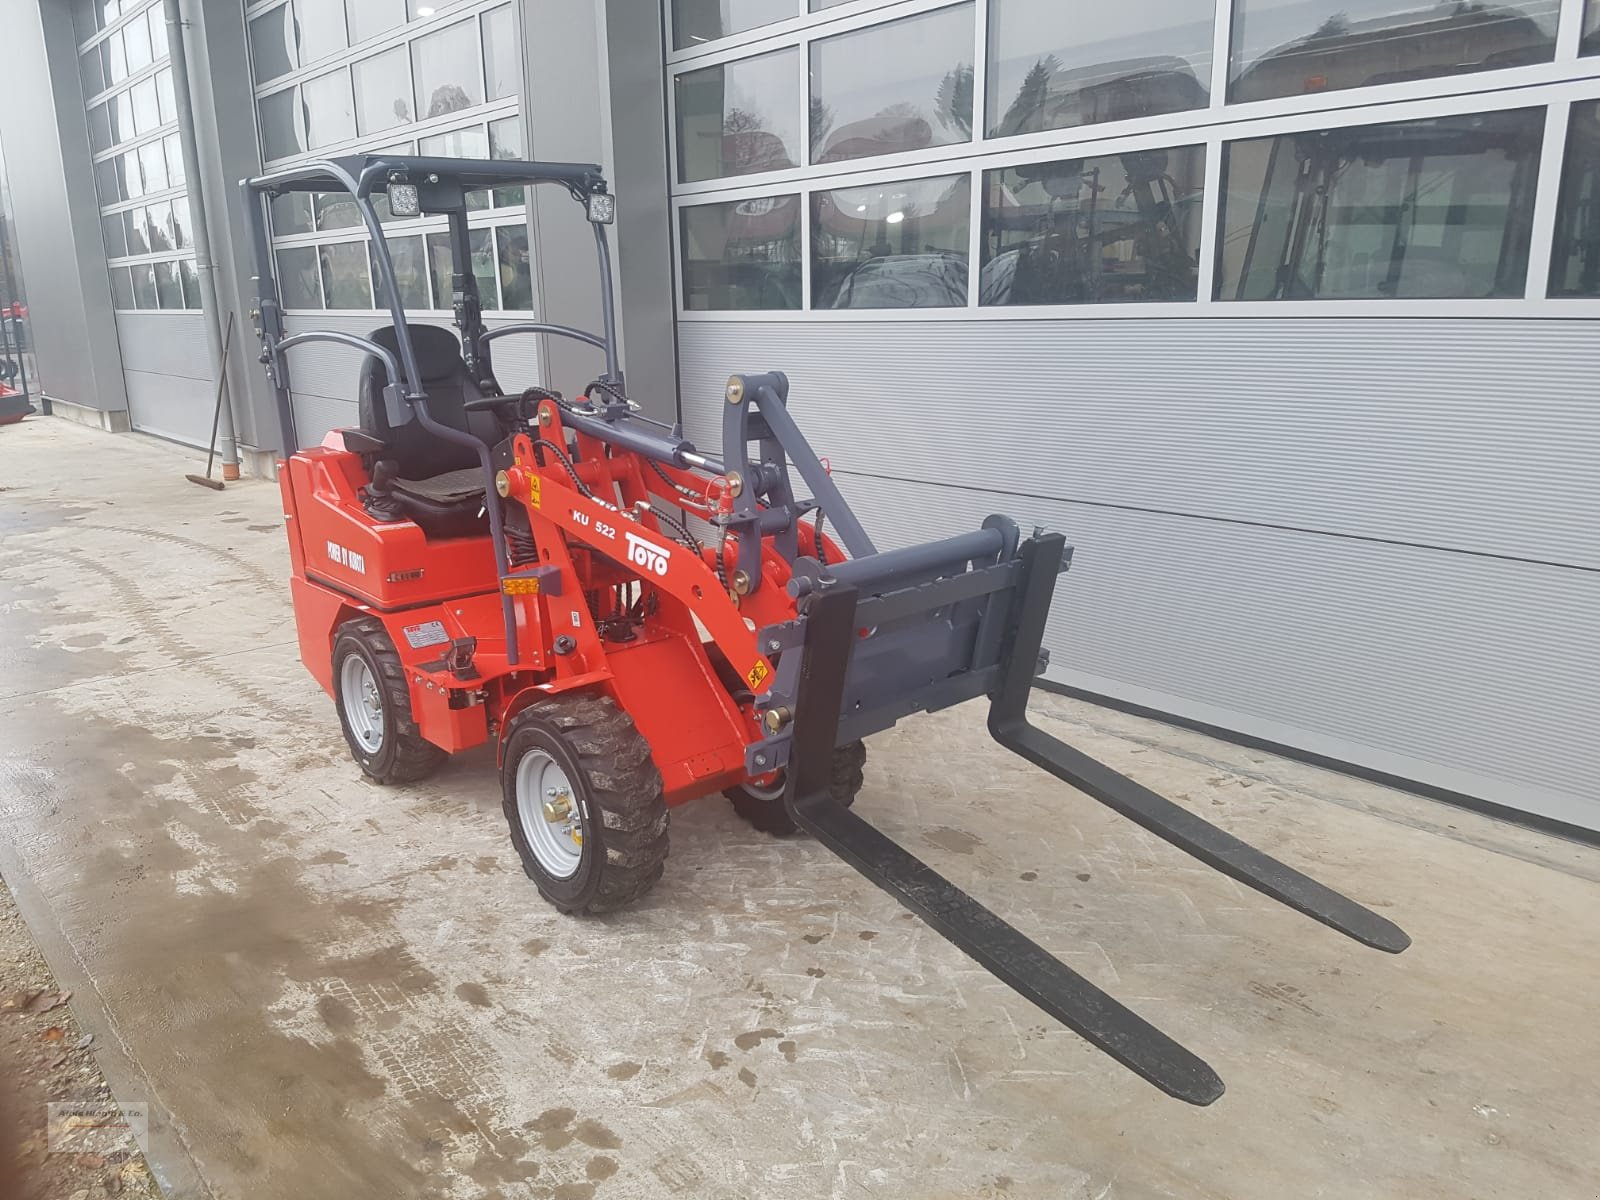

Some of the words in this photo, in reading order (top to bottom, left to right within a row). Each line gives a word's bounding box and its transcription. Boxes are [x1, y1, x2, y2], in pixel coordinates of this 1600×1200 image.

[573, 510, 589, 526] KU
[595, 521, 616, 540] 522
[625, 531, 671, 576] TOYO
